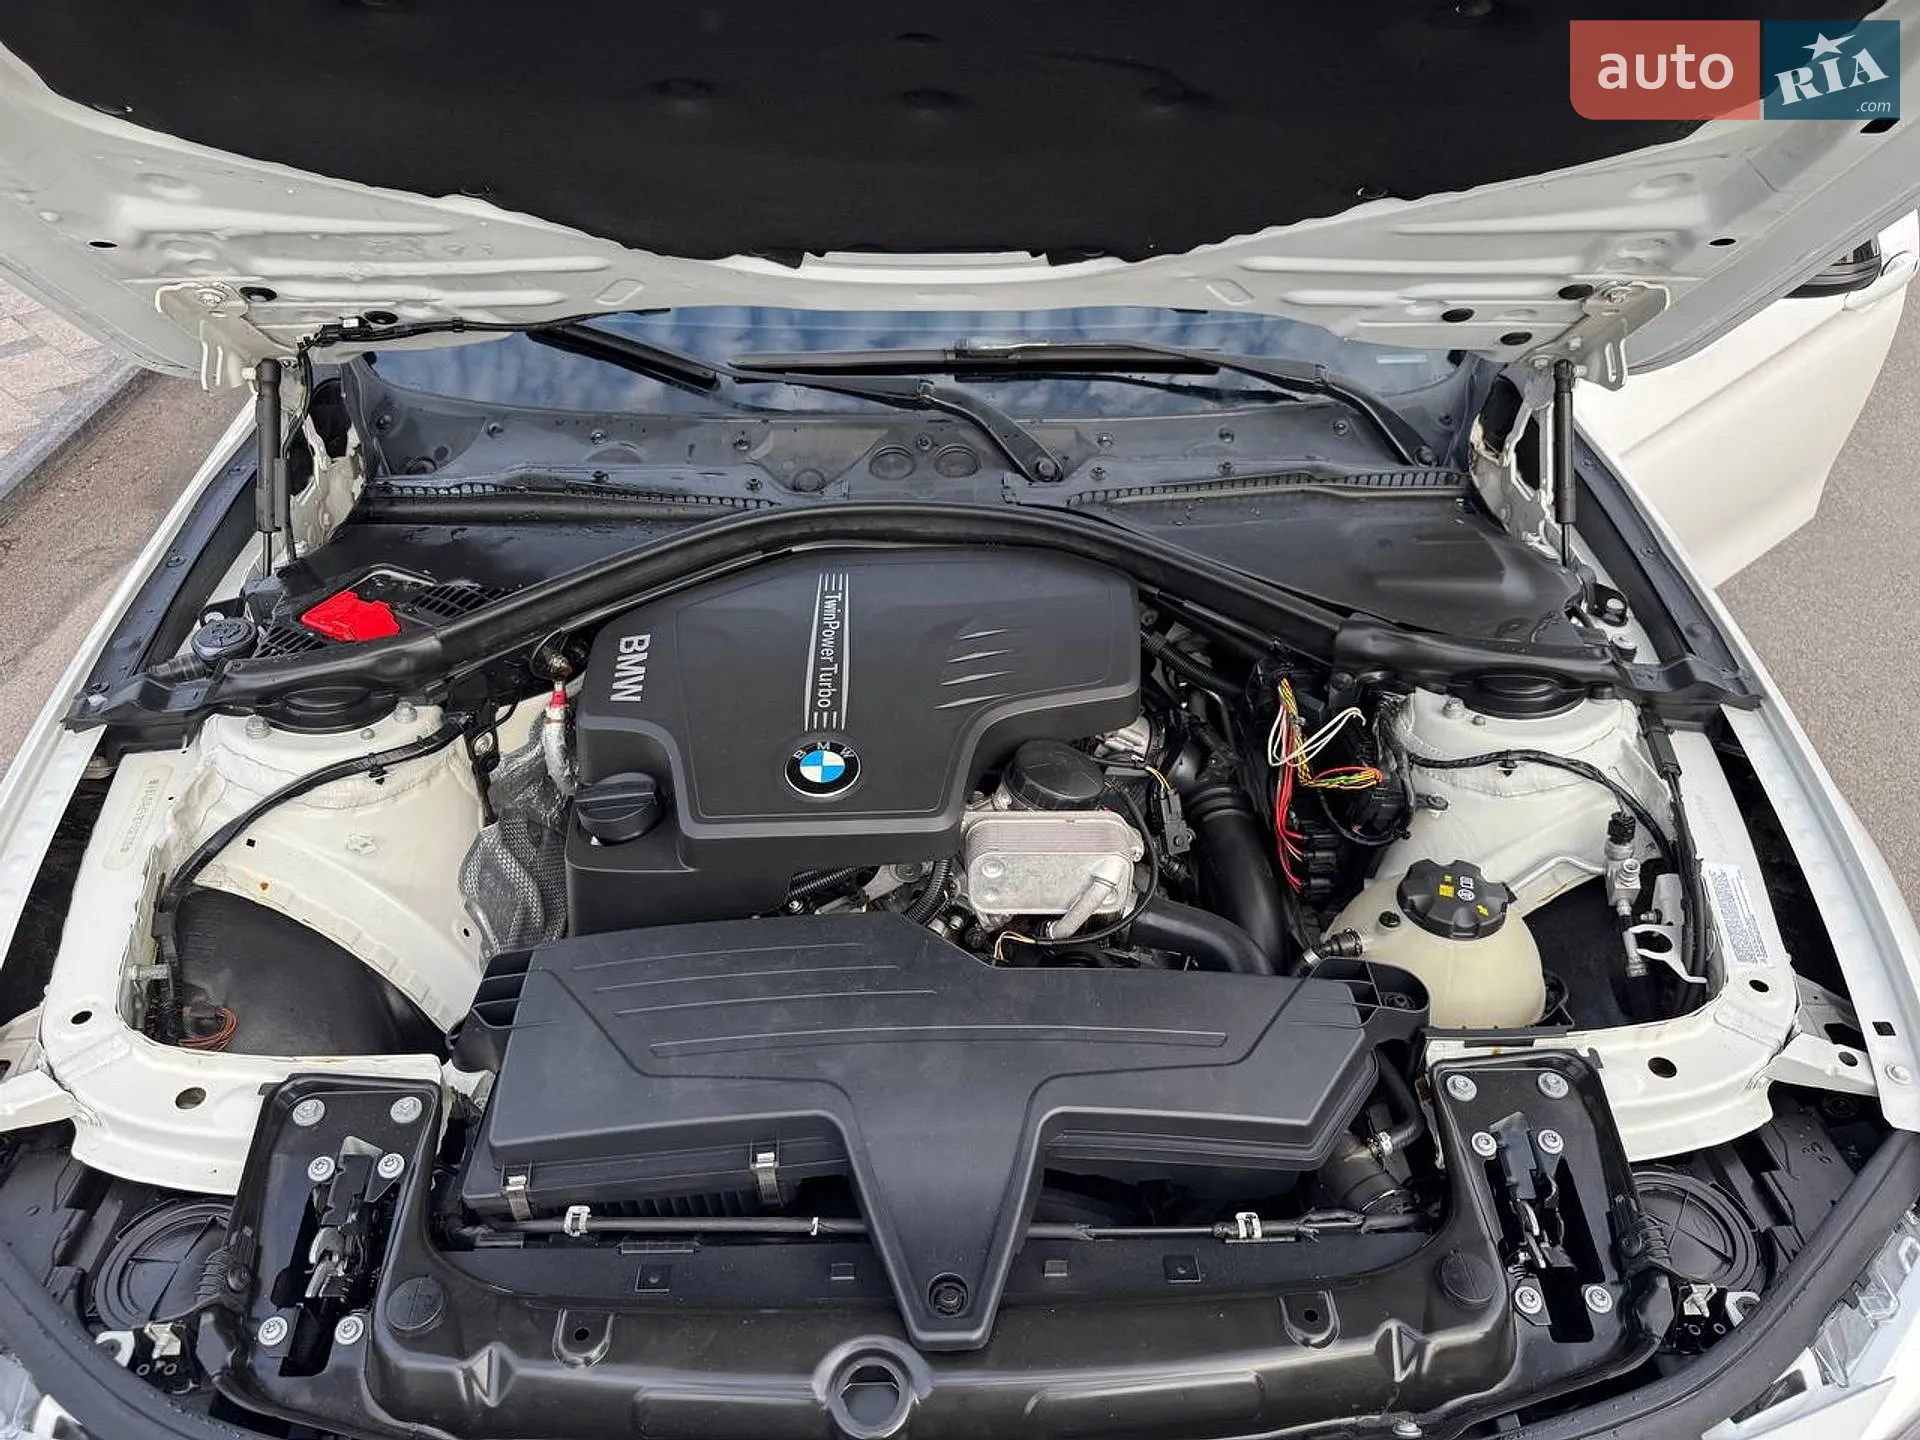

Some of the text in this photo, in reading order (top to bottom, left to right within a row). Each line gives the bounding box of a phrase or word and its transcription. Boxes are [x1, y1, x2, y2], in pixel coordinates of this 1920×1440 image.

[610, 634, 651, 702] BMW
[817, 592, 842, 708] TwinPower Turbo
[792, 742, 855, 760] BMW
